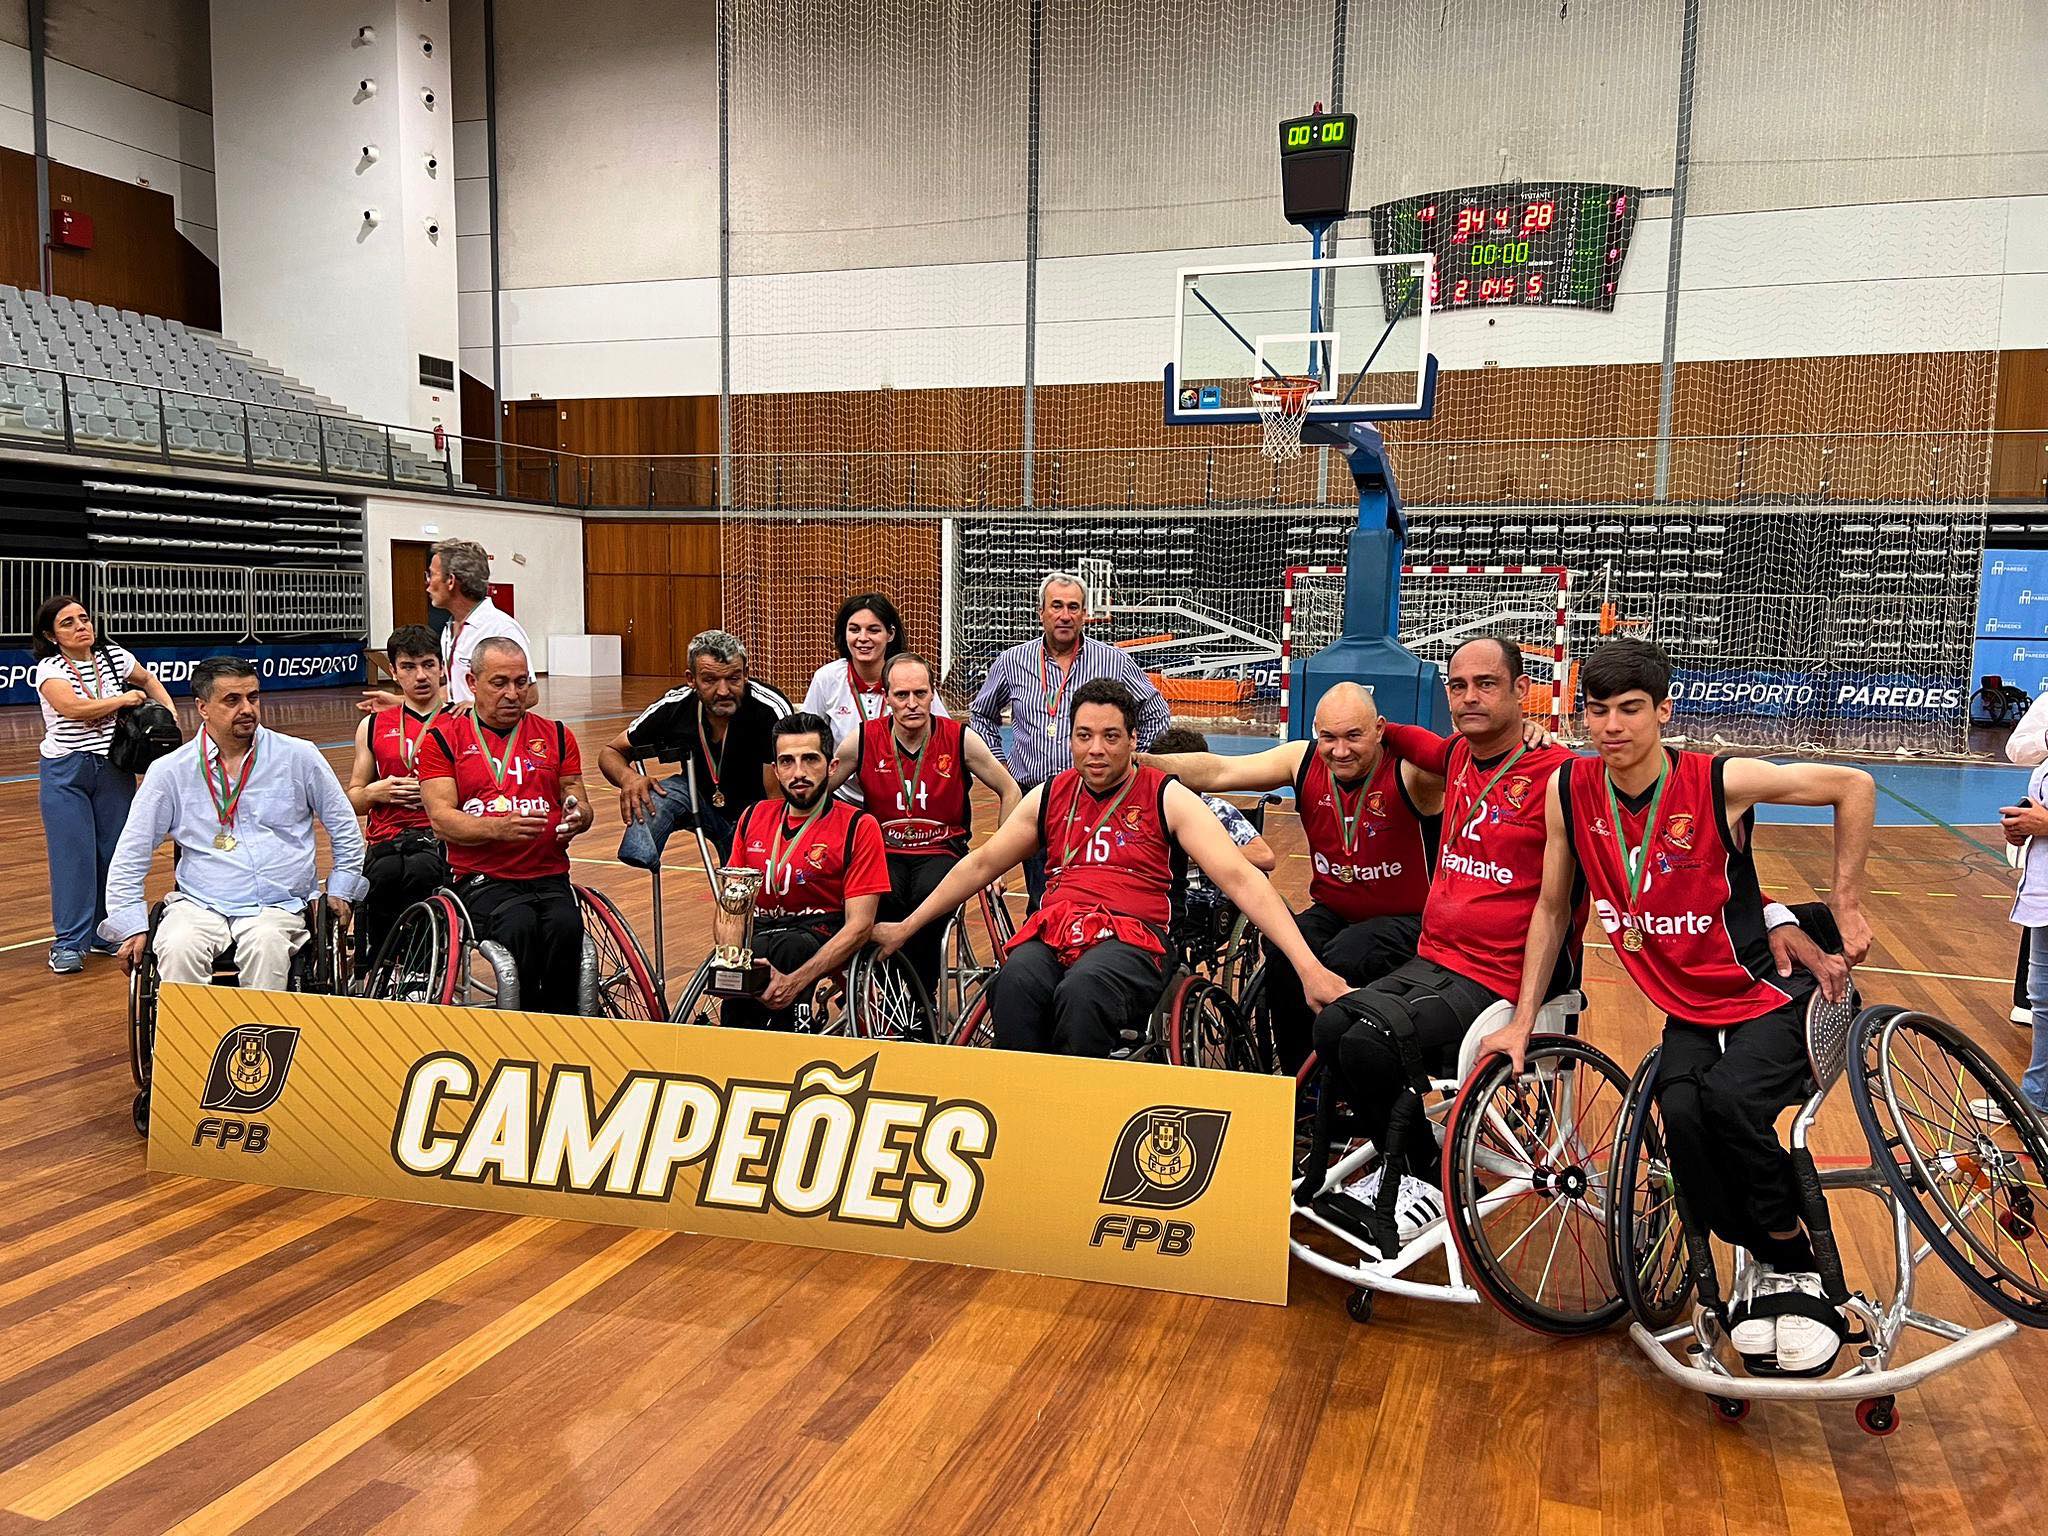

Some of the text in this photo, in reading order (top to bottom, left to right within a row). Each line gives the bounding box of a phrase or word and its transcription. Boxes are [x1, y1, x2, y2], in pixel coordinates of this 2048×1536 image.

[1288, 122, 1344, 146] 00:00
[1458, 203, 1553, 232] 34 4 28
[1472, 243, 1529, 266] 00:00
[1455, 279, 1469, 298] 2
[1529, 275, 1541, 294] 5
[262, 658, 275, 678] O
[278, 653, 359, 677] DESPORTO
[1667, 681, 1961, 710] O DESPORTO PAREDES
[486, 795, 550, 815] atarte
[1083, 826, 1112, 863] 15
[765, 858, 792, 896] 10
[1330, 861, 1403, 881] atarte
[192, 1117, 271, 1154] FPB
[391, 1050, 997, 1233] CAMPEÕES
[1089, 1213, 1194, 1257] FPB
